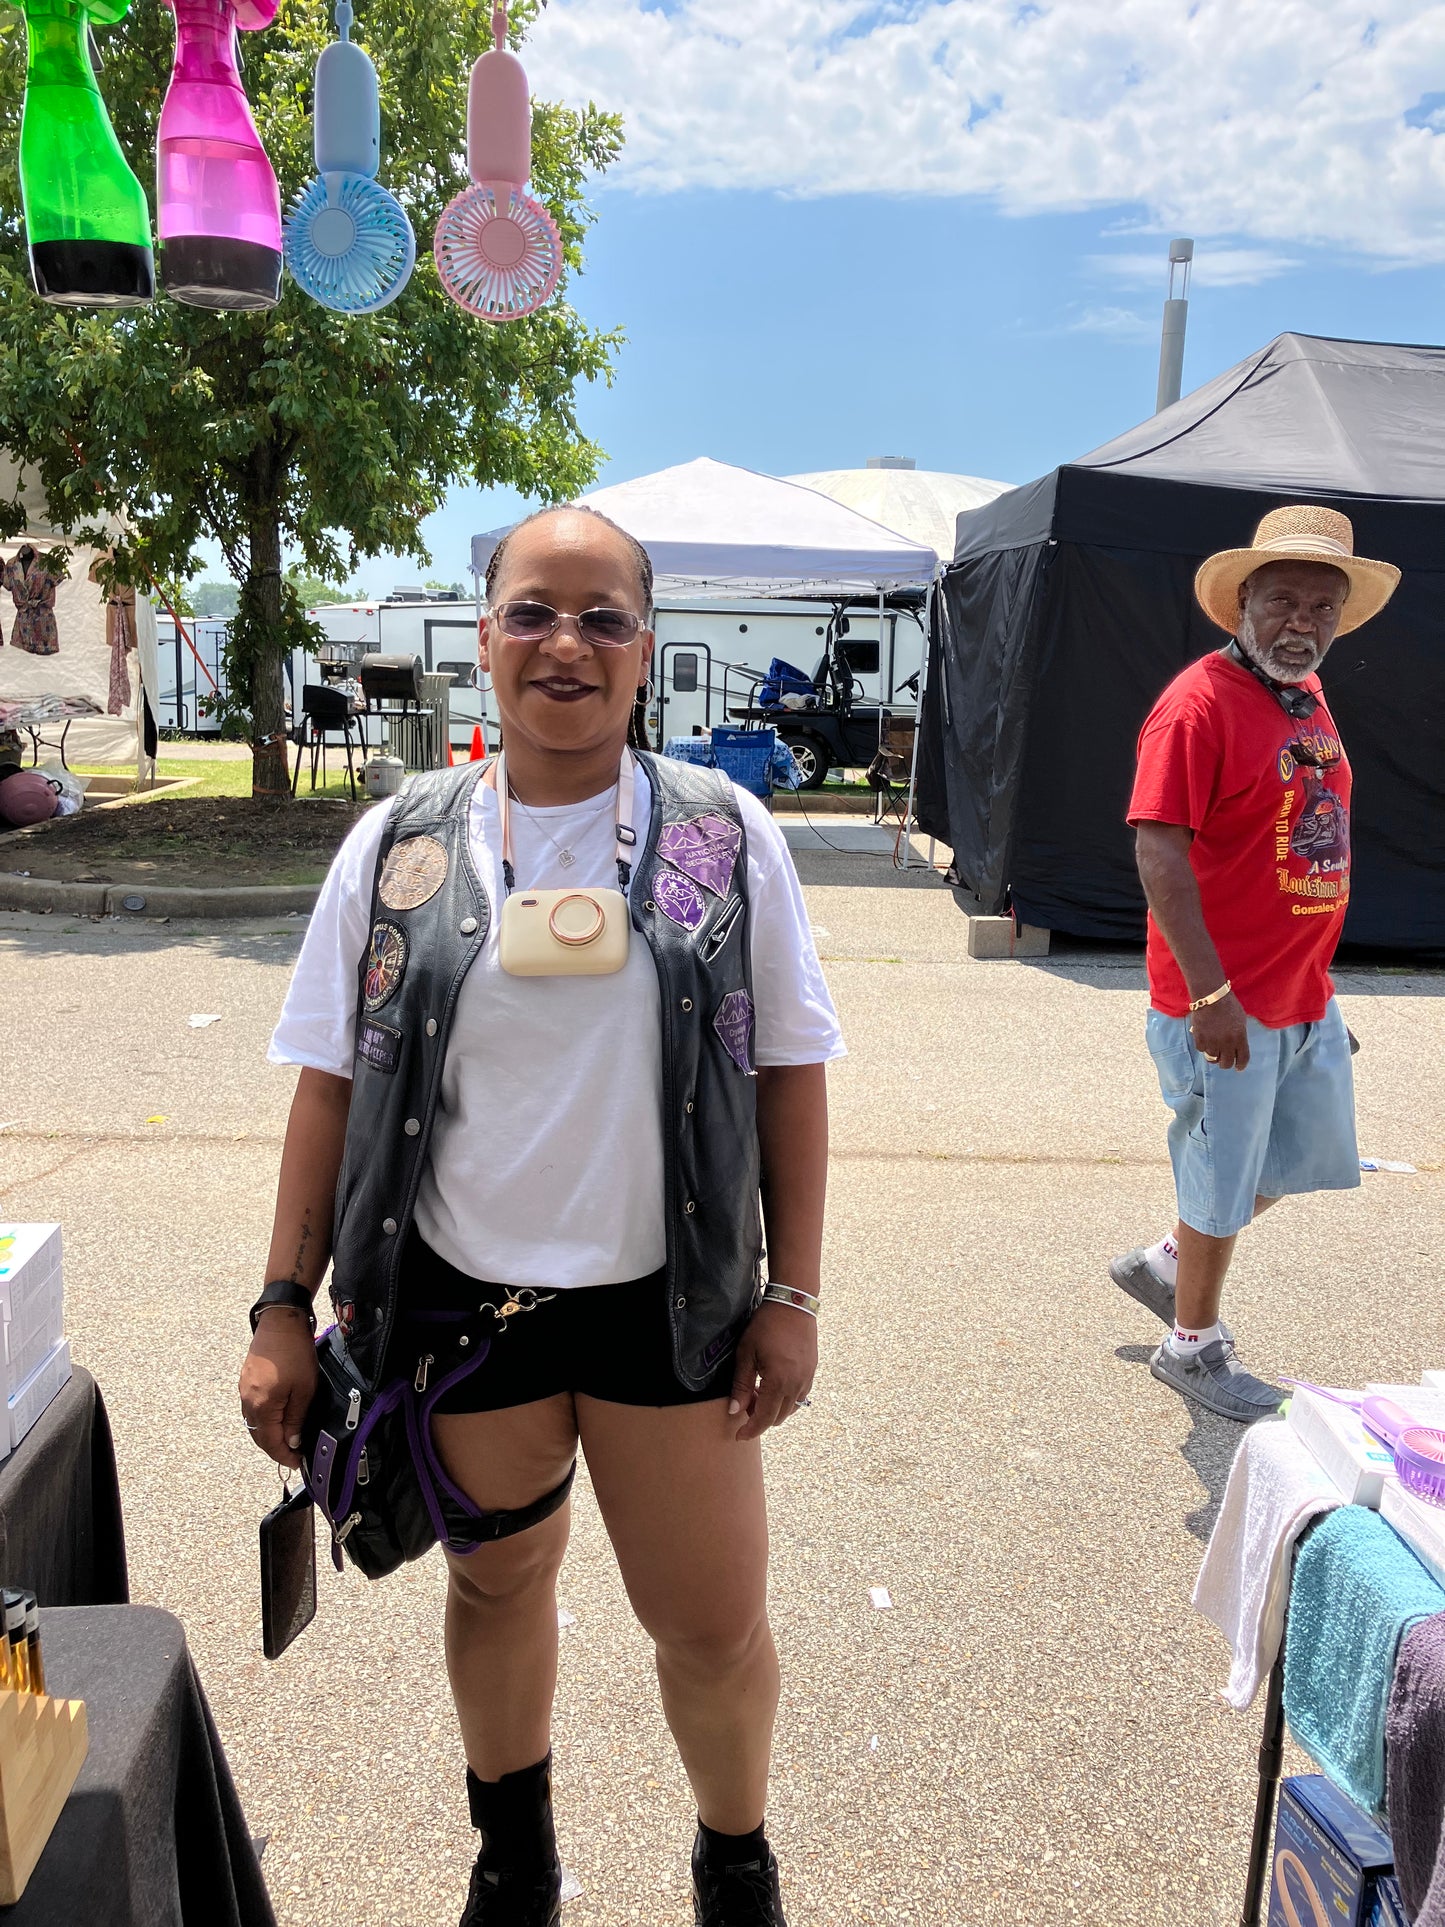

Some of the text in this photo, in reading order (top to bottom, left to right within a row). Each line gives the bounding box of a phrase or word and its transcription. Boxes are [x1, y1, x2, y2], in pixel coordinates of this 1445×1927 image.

[1275, 789, 1295, 862] BORN TO RIDE
[685, 842, 729, 860] NATIONAL
[685, 850, 734, 868] SECRETARY
[1308, 860, 1319, 874] A
[655, 872, 668, 910] DIAMOND
[690, 885, 704, 910] OVER
[1276, 867, 1339, 899] Louisiana
[388, 925, 406, 966] COALITION
